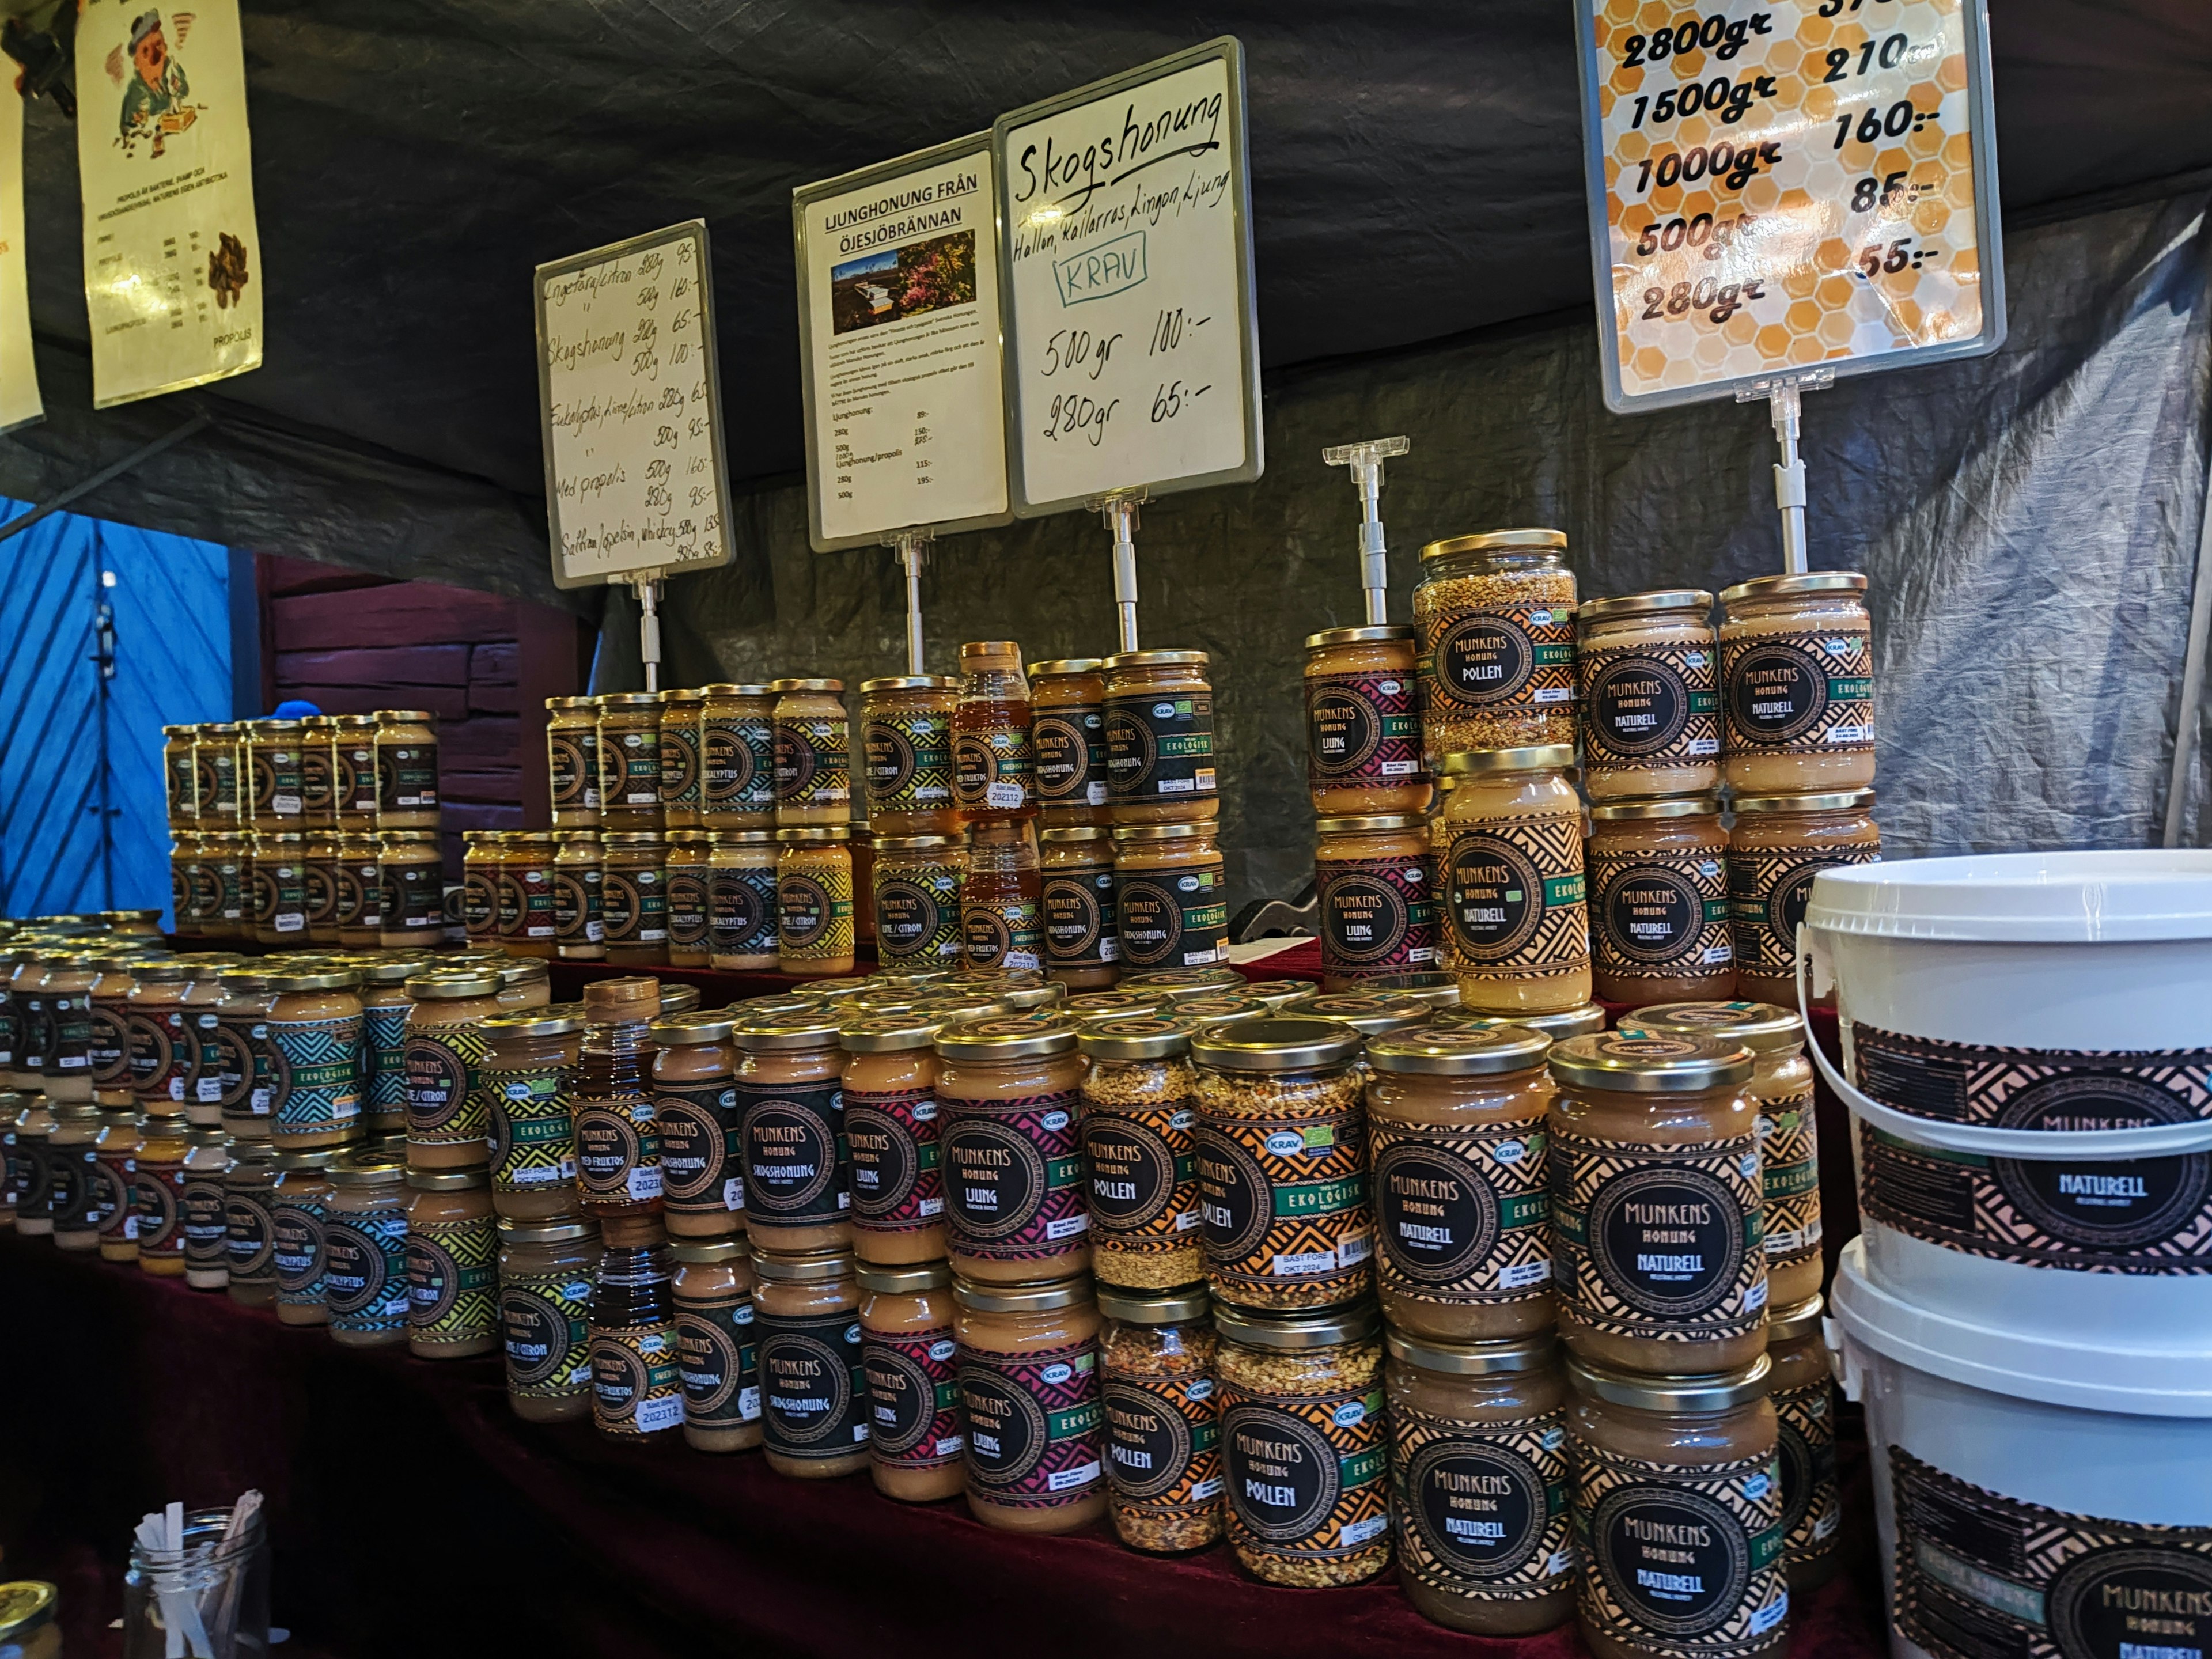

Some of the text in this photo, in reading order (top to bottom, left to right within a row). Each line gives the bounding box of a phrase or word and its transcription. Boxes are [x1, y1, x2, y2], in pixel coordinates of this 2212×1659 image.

[1015, 92, 1222, 217] Skogshonung
[825, 173, 977, 230] LJUNGHONUNG FRÅN
[840, 207, 961, 253] ÖJESJÖBRÄNNAN
[1066, 248, 1137, 298] KRAV
[213, 328, 252, 348] PROPOLIS
[1455, 636, 1507, 653] MUNKENS
[1827, 643, 1845, 651] KRAV
[1688, 657, 1703, 665] KRAV
[1463, 665, 1502, 681] POLLEN
[1745, 667, 1799, 684] MUNKENS
[1608, 680, 1661, 698] MUNKENS
[1755, 685, 1789, 696] HONUNG
[1618, 699, 1651, 709] HONUNG
[1752, 701, 1793, 714] NATURELL
[1313, 706, 1356, 721] MUNKENS
[1615, 714, 1657, 726] NATURELL
[1320, 723, 1347, 732] HONUNG
[1166, 741, 1208, 751] EKOLOGISK
[1456, 865, 1509, 885] MUNKENS
[1465, 889, 1498, 899] HONUNG
[1622, 889, 1677, 904] MUNKENS
[882, 899, 917, 911] MUNKENS
[1047, 897, 1081, 910] MUNKENS
[1124, 902, 1160, 914] MUNKENS
[1334, 895, 1382, 909] MUNKENS
[1343, 911, 1373, 919] HONUNG
[1464, 907, 1506, 922] NATURELL
[1633, 907, 1666, 916] HONUNG
[898, 923, 922, 933] CITRON
[968, 925, 994, 934] MUNKENS
[1630, 922, 1672, 934] NATURELL
[1044, 1118, 1066, 1127] KRAV
[581, 1130, 618, 1142] MUNKENS
[753, 1126, 806, 1143] MUNKENS
[763, 1146, 796, 1157] HONUNG
[1088, 1141, 1142, 1162] MUNKENS
[1270, 1140, 1300, 1150] KRAV
[593, 1156, 624, 1166] FRUKTOS
[952, 1147, 1012, 1166] MUNKENS
[753, 1164, 815, 1178] SKOGSHONUNG
[962, 1168, 999, 1180] HONUNG
[1095, 1163, 1130, 1176] HONUNG
[1094, 1179, 1136, 1200] POLLEN
[1391, 1174, 1460, 1202] MUNKENS
[2058, 1175, 2149, 1198] NATURELL
[1289, 1187, 1360, 1208] EKOLOGISK
[1402, 1202, 1445, 1217] HONUNG
[1624, 1203, 1711, 1225] MUNKENS
[1399, 1221, 1453, 1244] NATURELL
[1642, 1230, 1696, 1244] HONUNG
[1302, 1264, 1320, 1272] 2024
[1637, 1253, 1705, 1272] NATURELL
[769, 1357, 821, 1377] MUNKENS
[1044, 1370, 1069, 1378] KRAV
[963, 1389, 1012, 1417] MUNKENS
[1336, 1409, 1363, 1421] KRAV
[1111, 1443, 1152, 1469] POLLEN
[1237, 1433, 1303, 1464] MUNKENS
[1434, 1469, 1512, 1495] MUNKENS
[1245, 1479, 1296, 1507] POLLEN
[1446, 1517, 1507, 1539] NATURELL
[1624, 1516, 1711, 1547] MUNKENS
[1637, 1568, 1705, 1593] NATURELL
[2103, 1584, 2212, 1616] MUNKENS
